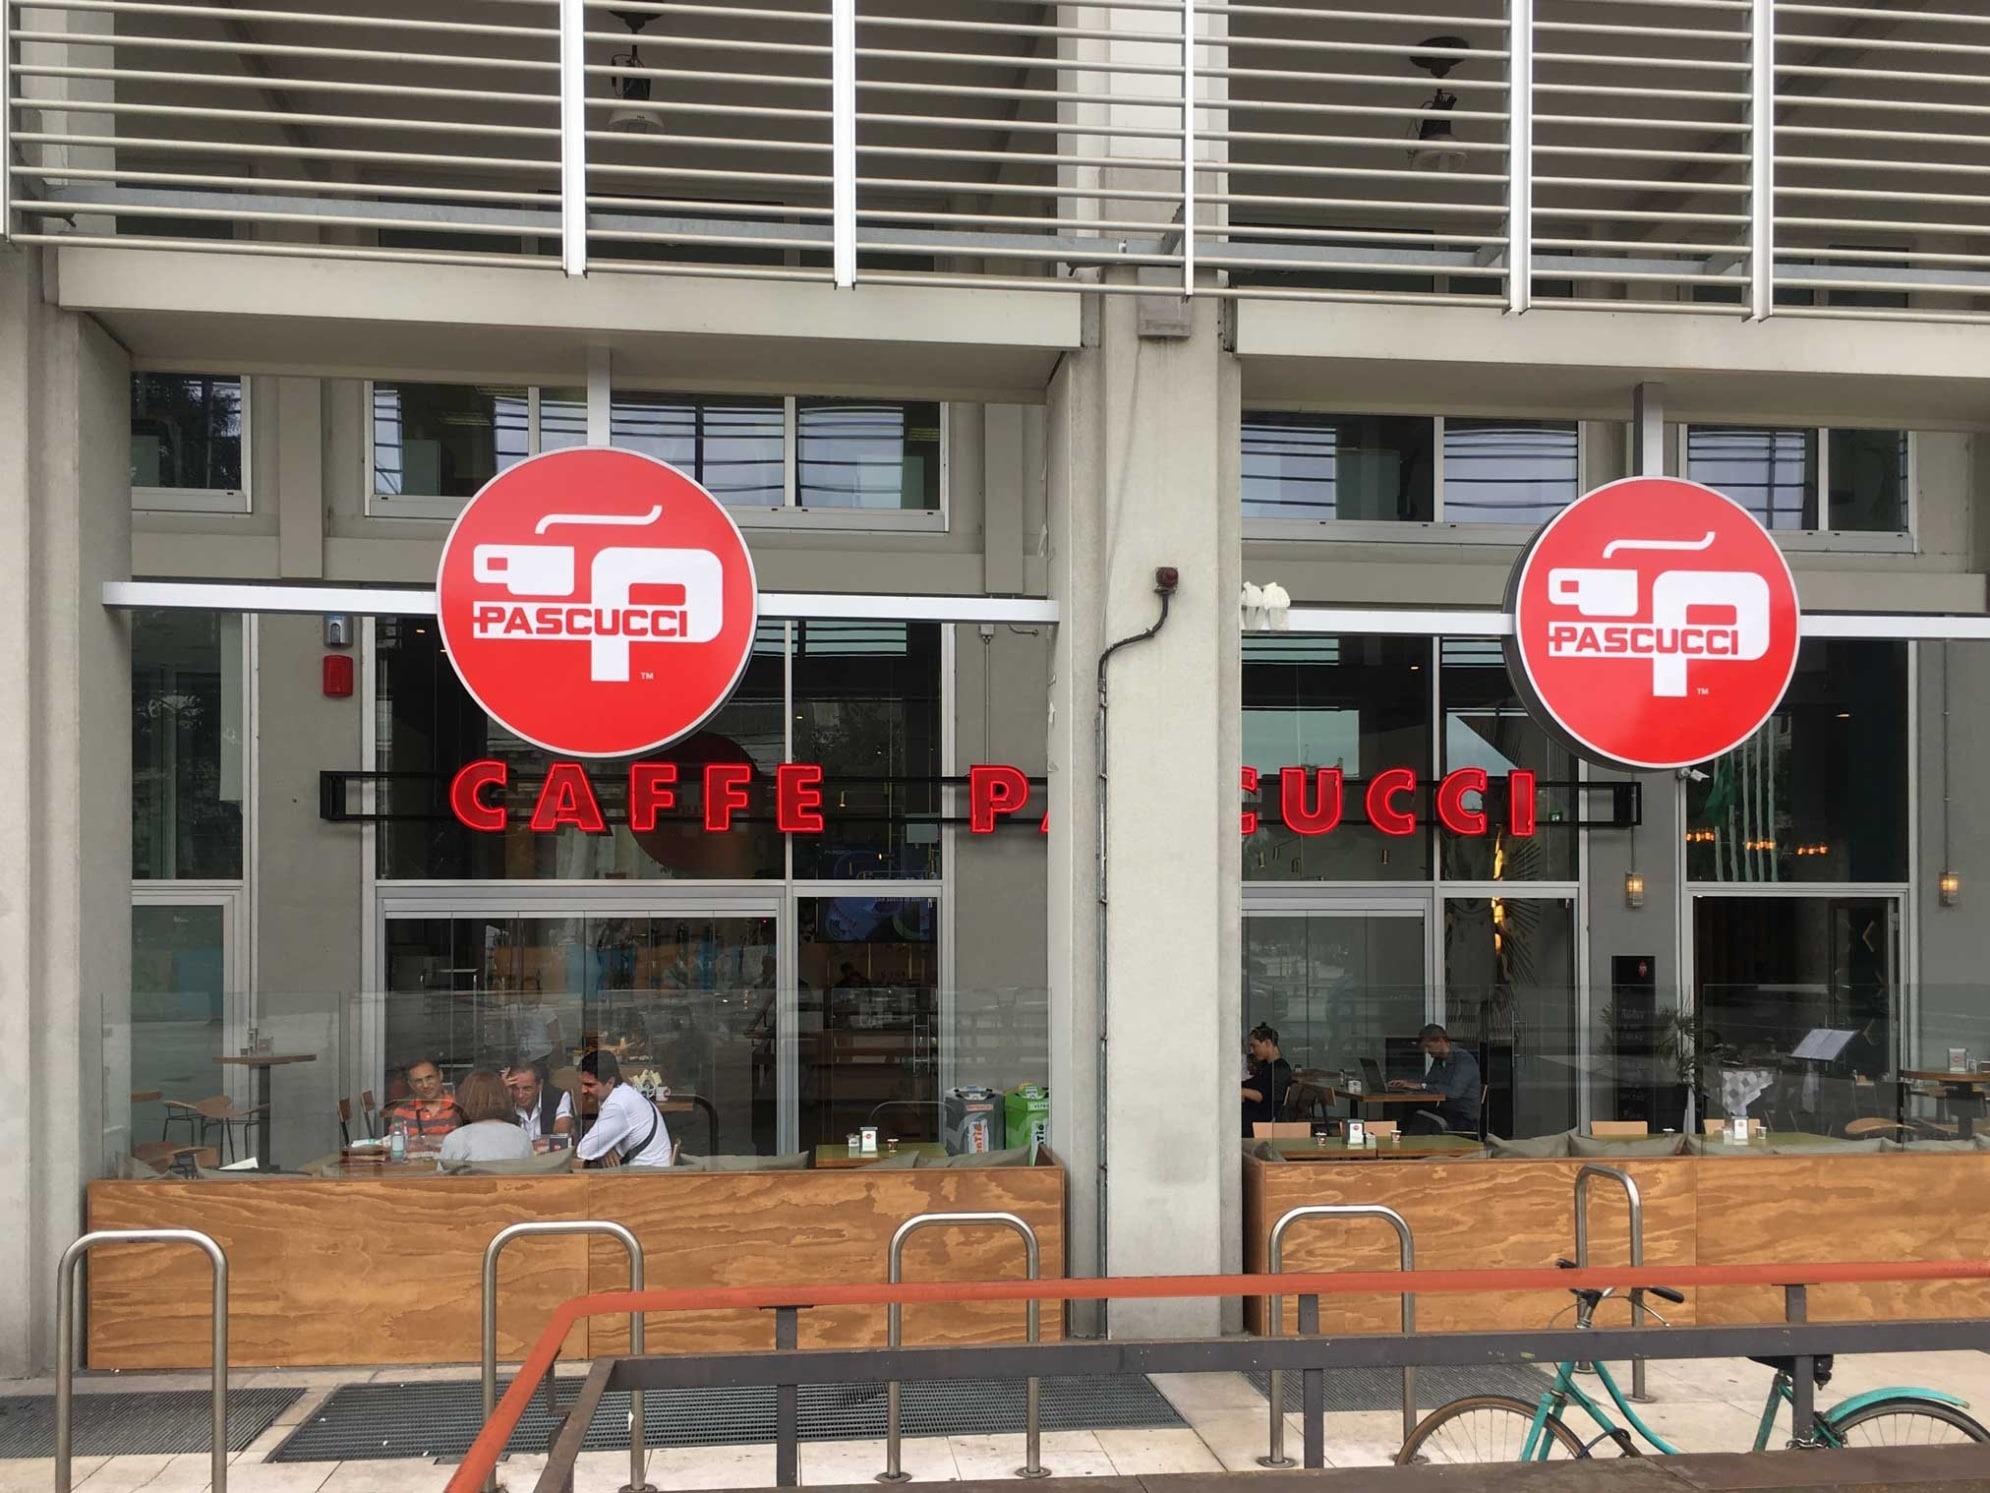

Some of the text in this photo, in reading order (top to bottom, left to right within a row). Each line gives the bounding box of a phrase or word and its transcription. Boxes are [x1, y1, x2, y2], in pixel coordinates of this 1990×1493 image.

[476, 606, 688, 638] PASCUCCI
[1552, 626, 1739, 656] PASCUCCI
[640, 672, 654, 681] TM
[1696, 688, 1709, 696] TM
[449, 760, 825, 835] CAFFE
